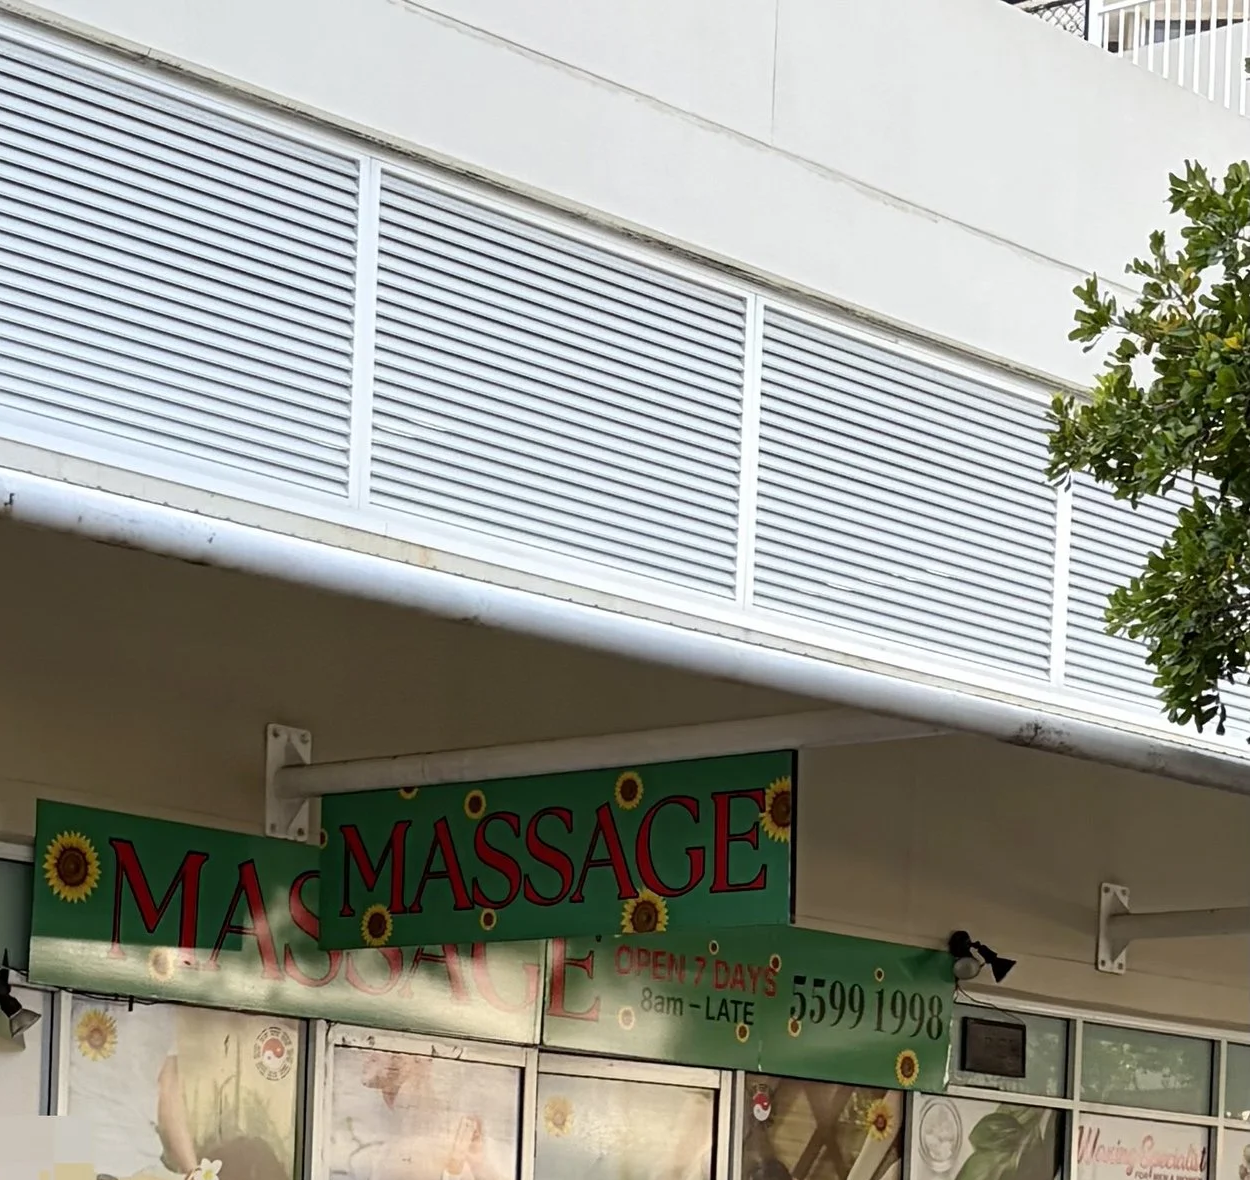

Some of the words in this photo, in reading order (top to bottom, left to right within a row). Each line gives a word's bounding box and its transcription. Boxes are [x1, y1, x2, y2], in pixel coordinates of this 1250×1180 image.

[339, 788, 767, 918] MASSAGE
[614, 944, 687, 985] OPEN
[692, 956, 706, 987] 7
[712, 959, 778, 998] DAYS
[640, 986, 685, 1017] 8am
[704, 995, 755, 1026] LATE
[789, 974, 865, 1030] 5599
[872, 987, 944, 1041] 1998
[1134, 1171, 1150, 1180] FOR
